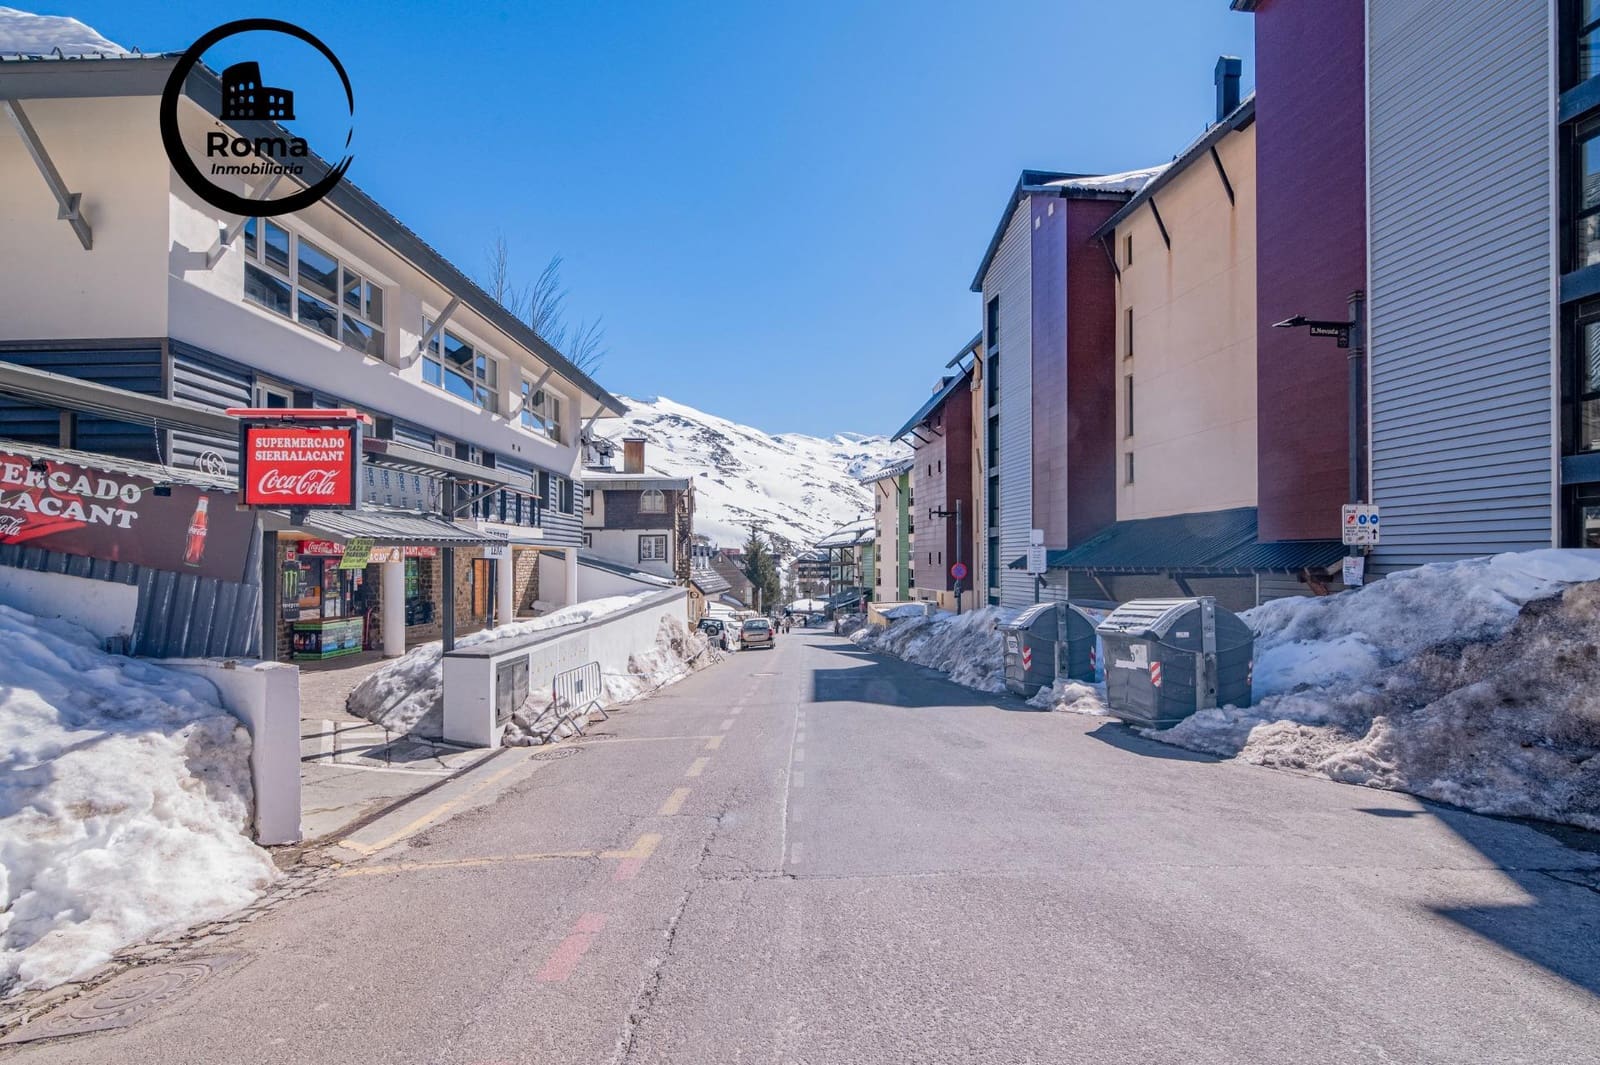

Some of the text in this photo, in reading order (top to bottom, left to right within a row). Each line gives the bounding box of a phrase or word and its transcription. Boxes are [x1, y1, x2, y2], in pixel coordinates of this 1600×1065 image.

[255, 437, 345, 449] SUPERMERCADO
[255, 450, 345, 462] SIERRALACANT
[0, 461, 142, 504] ERCADO
[257, 468, 341, 495] Coca-Cola
